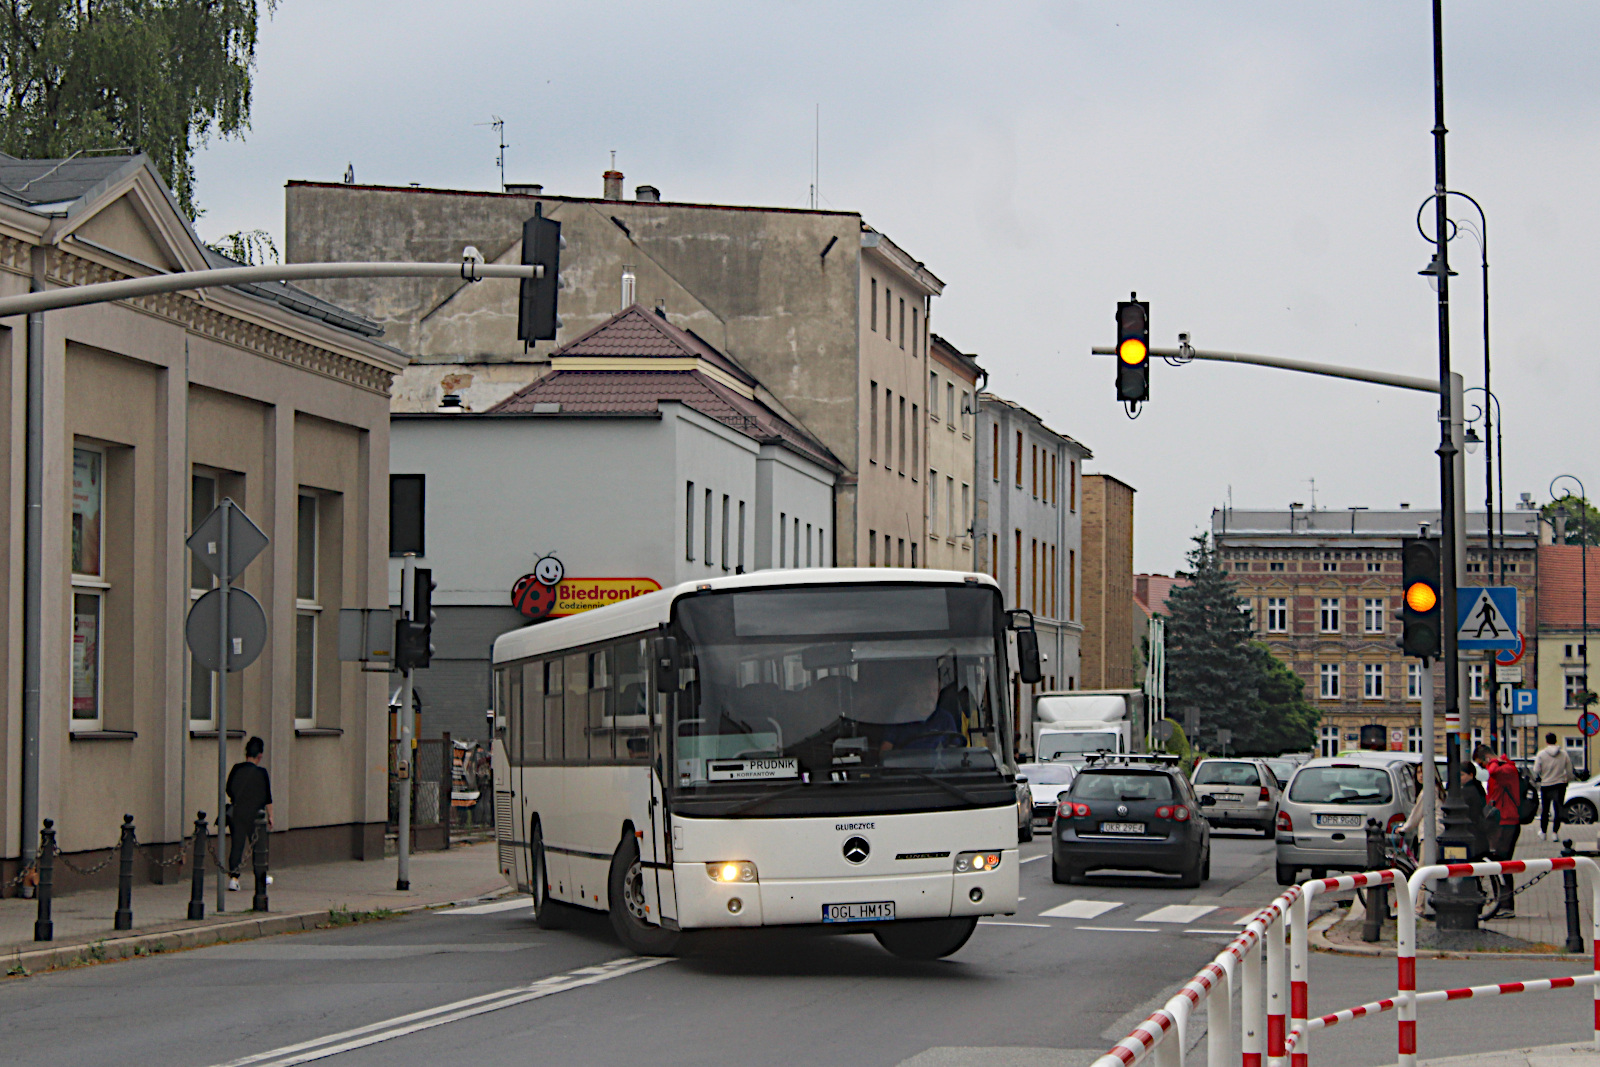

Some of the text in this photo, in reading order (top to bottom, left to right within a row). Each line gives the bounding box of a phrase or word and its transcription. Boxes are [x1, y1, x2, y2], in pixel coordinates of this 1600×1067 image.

[1518, 691, 1533, 711] P
[750, 760, 795, 770] PRUDNIK
[1322, 815, 1339, 824] OPR
[835, 822, 876, 831] GŁUBCZYCE
[831, 903, 892, 919] OGL HM15
